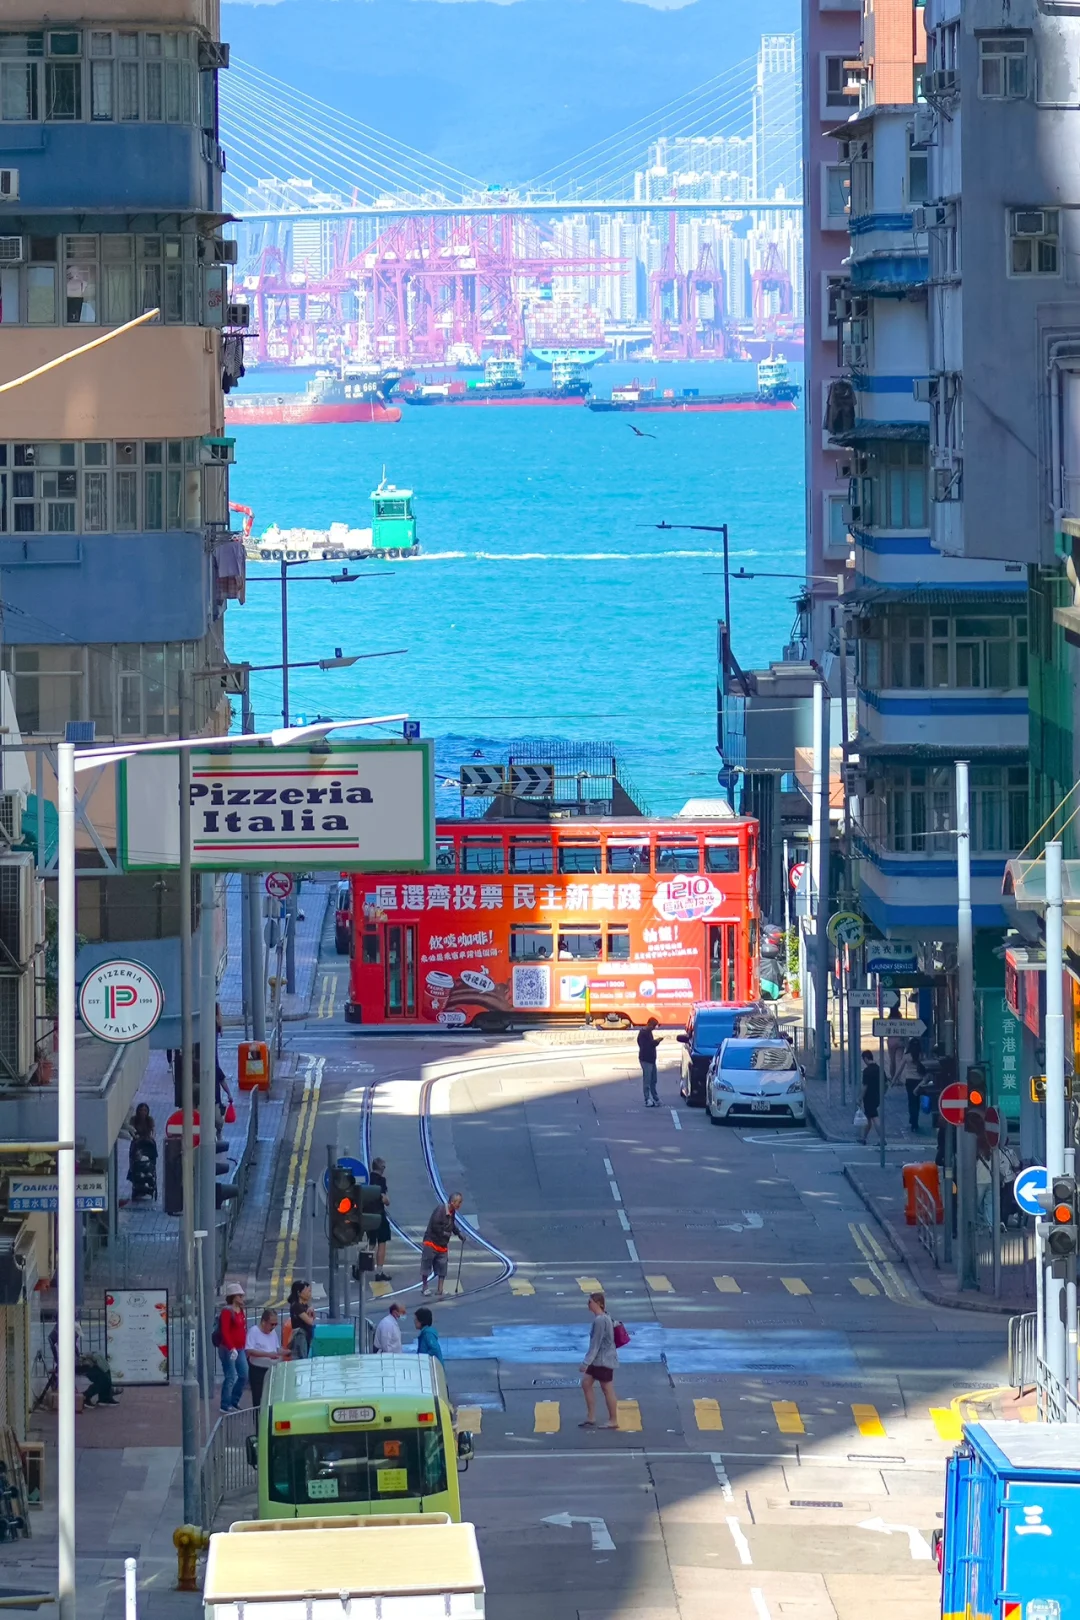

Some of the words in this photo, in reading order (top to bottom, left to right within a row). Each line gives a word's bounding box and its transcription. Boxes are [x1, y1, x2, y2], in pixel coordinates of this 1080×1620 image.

[363, 382, 377, 392] 666
[406, 722, 417, 737] P
[178, 781, 374, 806] Pizzeria
[203, 809, 349, 833] Italia
[376, 884, 504, 911] 區選齊投票
[666, 879, 710, 900] 1210
[97, 969, 142, 983] PIZZERIA
[104, 1023, 138, 1033] ITALIA
[1002, 1018, 1017, 1089] 香港置業
